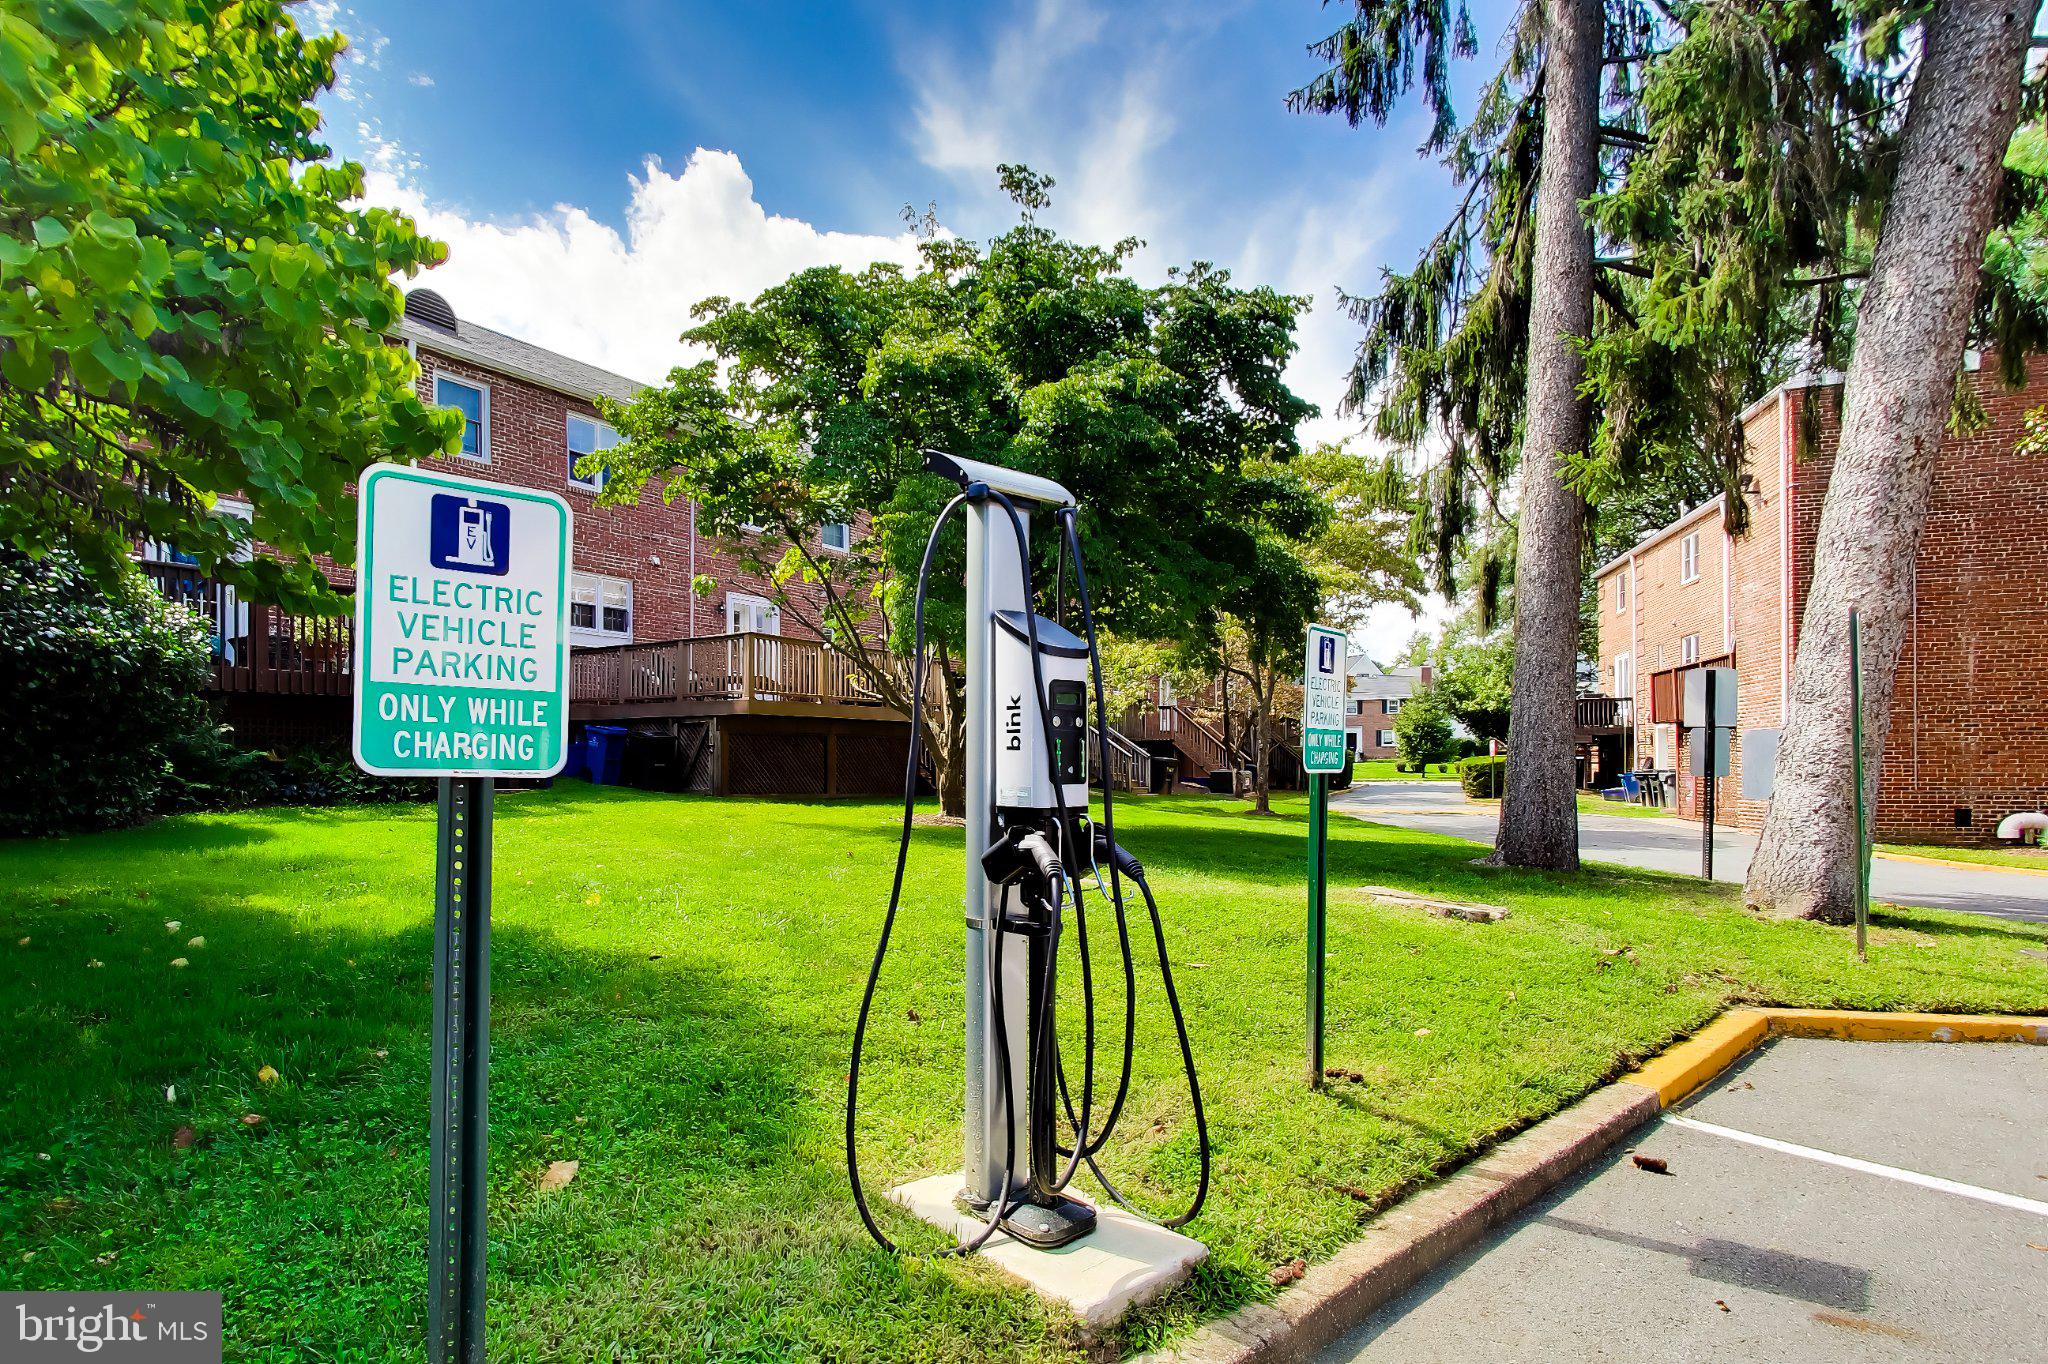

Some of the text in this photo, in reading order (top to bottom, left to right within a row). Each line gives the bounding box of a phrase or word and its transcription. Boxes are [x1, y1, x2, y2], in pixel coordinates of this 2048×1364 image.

[389, 574, 543, 616] ELECTRIC
[396, 611, 537, 649] VEHICLE
[392, 647, 538, 682] PARKING
[1310, 677, 1341, 693] ELECTRIC
[378, 692, 548, 727] ONLY WHILE
[1311, 693, 1339, 709] VEHICLE
[1006, 693, 1021, 751] blink
[1310, 711, 1340, 726] PARKING
[393, 731, 534, 761] CHARGING
[1308, 733, 1342, 748] ONLY WHILE
[1310, 750, 1339, 765] CHARGING
